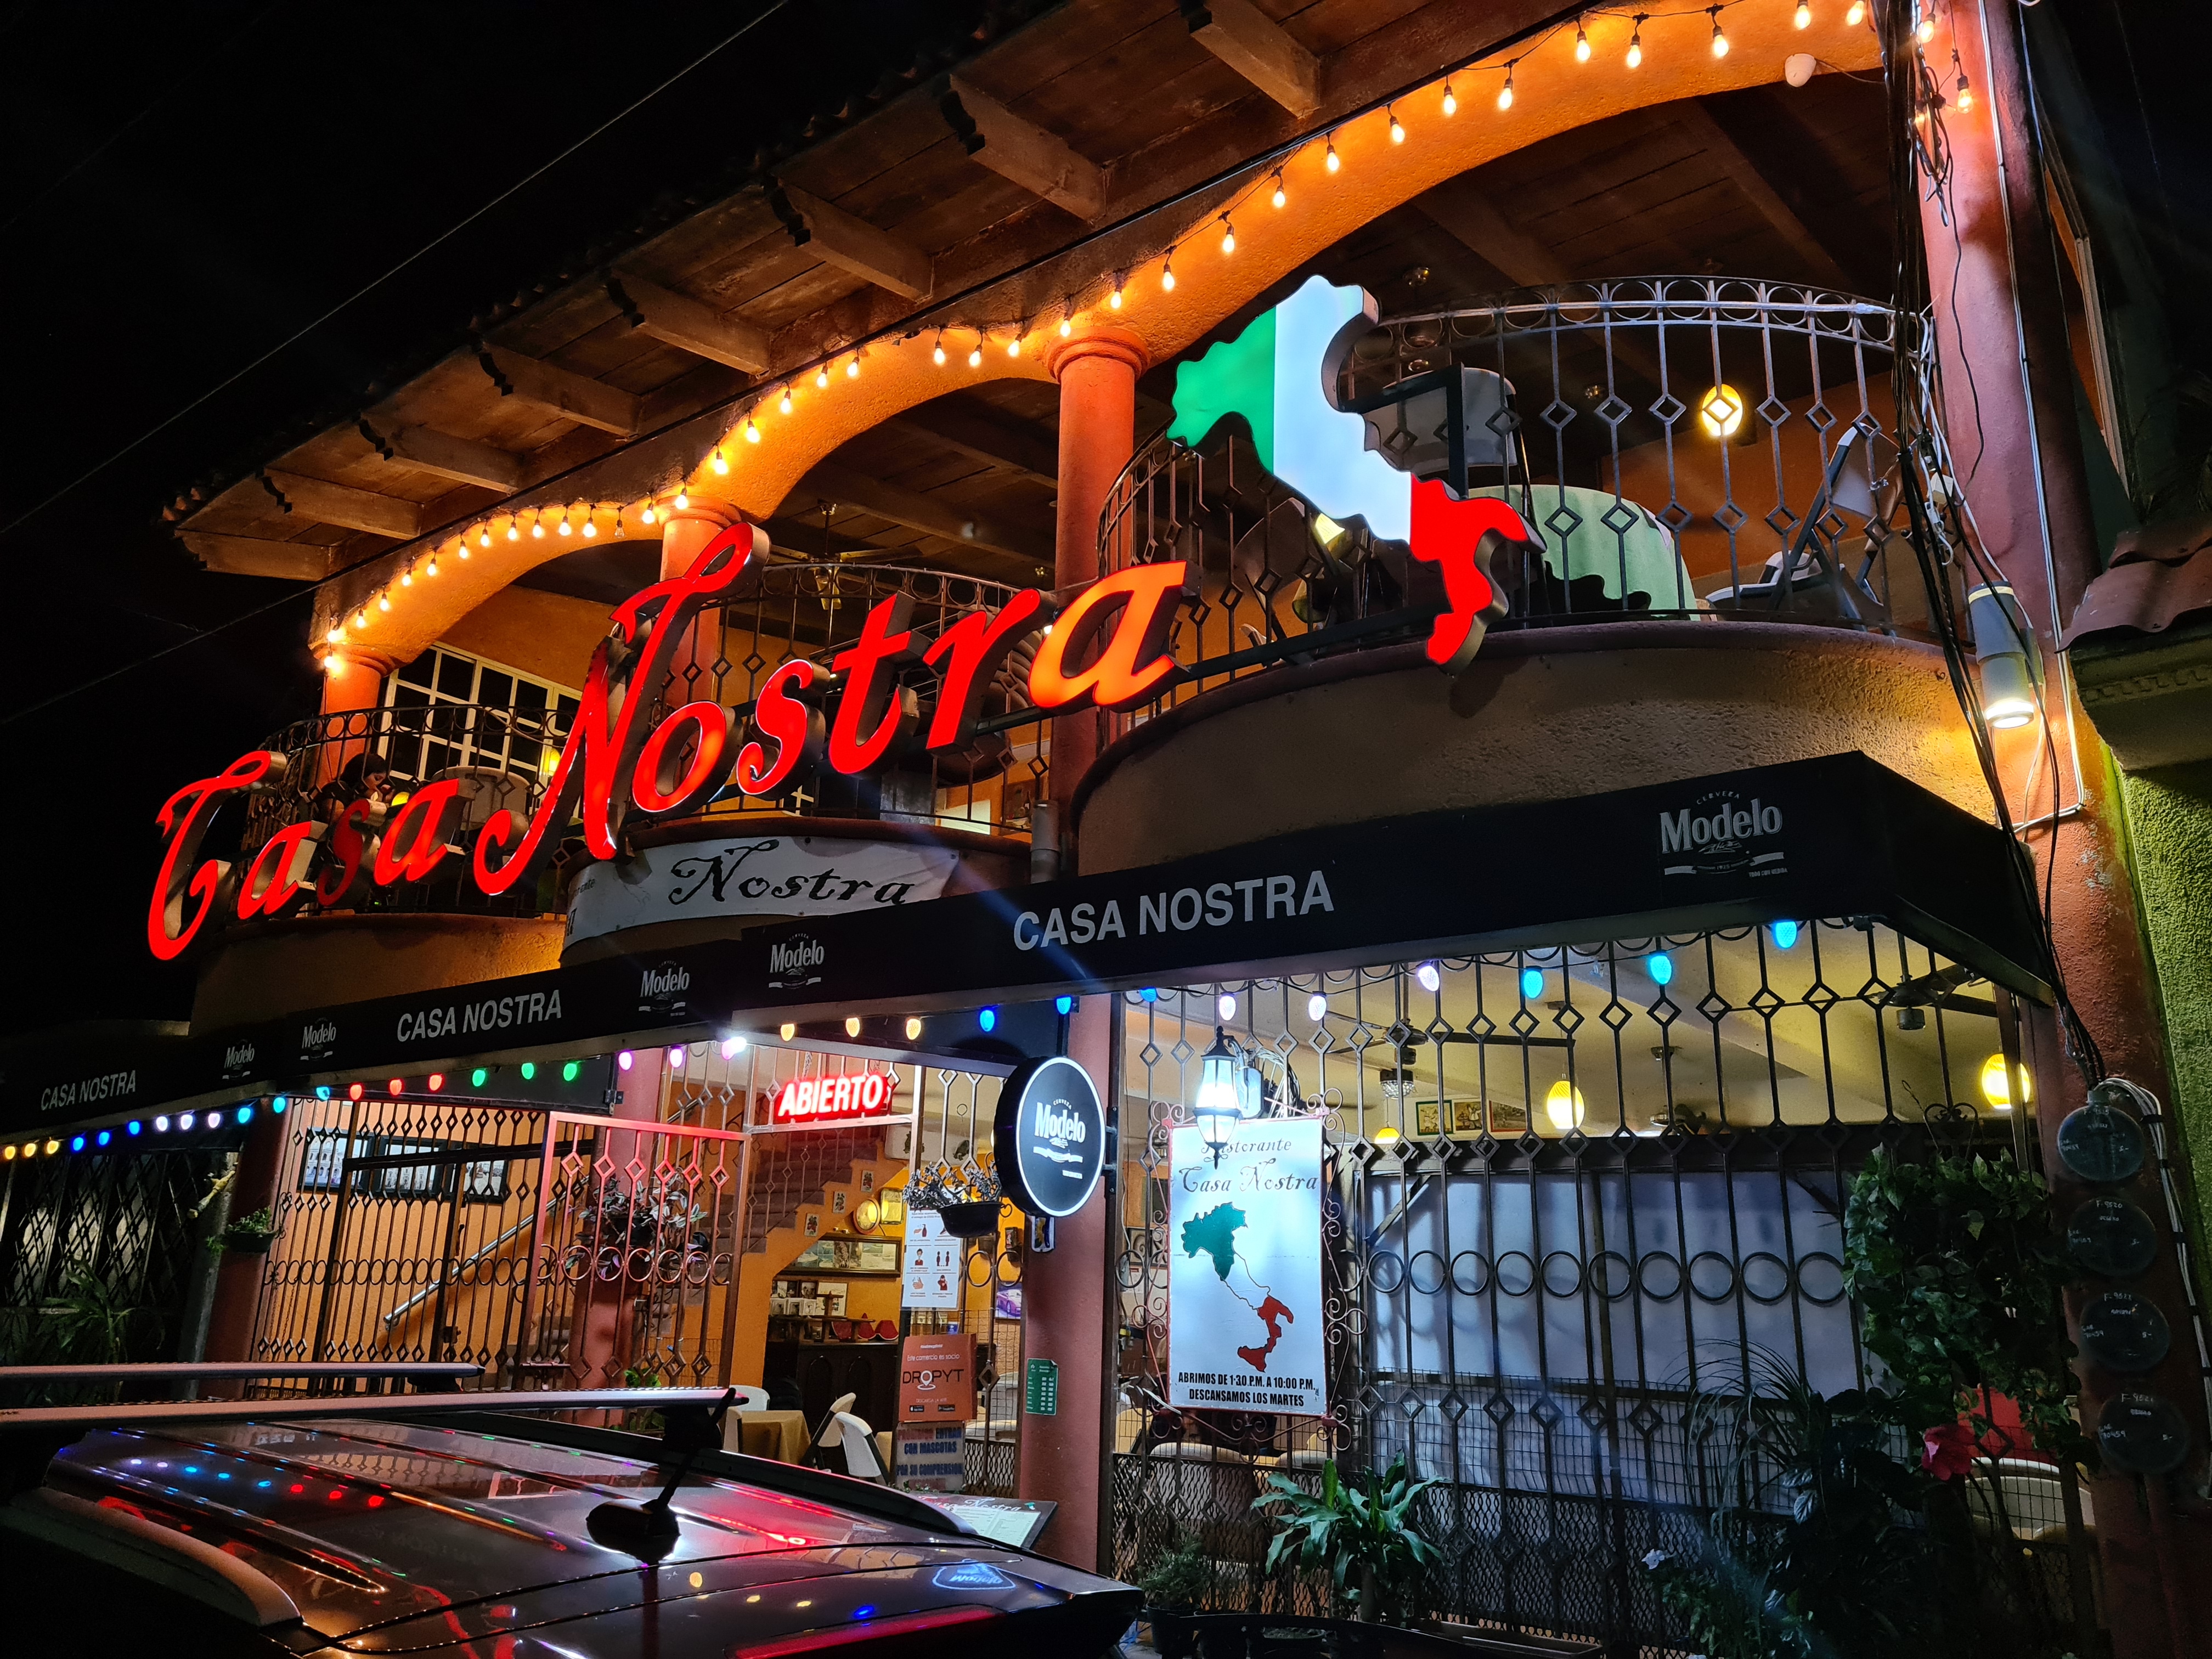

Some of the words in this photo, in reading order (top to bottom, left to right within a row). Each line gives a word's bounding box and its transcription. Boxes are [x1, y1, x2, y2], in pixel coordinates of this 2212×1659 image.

[148, 750, 459, 960] Casa
[473, 522, 1187, 895] Nostra
[1696, 791, 1740, 805] CERVEZA
[1660, 798, 1782, 854] Modelo
[668, 839, 915, 905] Nostra
[1013, 900, 1126, 951] CASA
[1139, 870, 1334, 935] NOSTRA
[770, 940, 825, 974] Modelo
[639, 967, 691, 998] Modelo
[397, 1007, 456, 1042] CASA
[462, 990, 561, 1033] NOSTRA
[302, 1022, 337, 1049] Modelo
[224, 1043, 255, 1069] Modelo
[41, 1083, 76, 1111] CASA
[78, 1069, 136, 1103] NOSTRA
[777, 1075, 883, 1117] ABIERTO
[1053, 1098, 1072, 1110] CERVEZA
[1034, 1102, 1086, 1143] Modelo
[1178, 1166, 1232, 1192] Casa
[1239, 1158, 1319, 1192] Nostra
[1178, 1372, 1216, 1385] ABRIMOS
[1218, 1374, 1228, 1385] DE
[1266, 1376, 1272, 1387] A
[1274, 1377, 1296, 1389] 10:00
[1189, 1389, 1251, 1403] DESCANSAMOS
[1253, 1392, 1268, 1404] LOS
[1270, 1393, 1304, 1407] MARTES
[904, 1443, 918, 1455] CON
[919, 1441, 957, 1454] MASCOTAS
